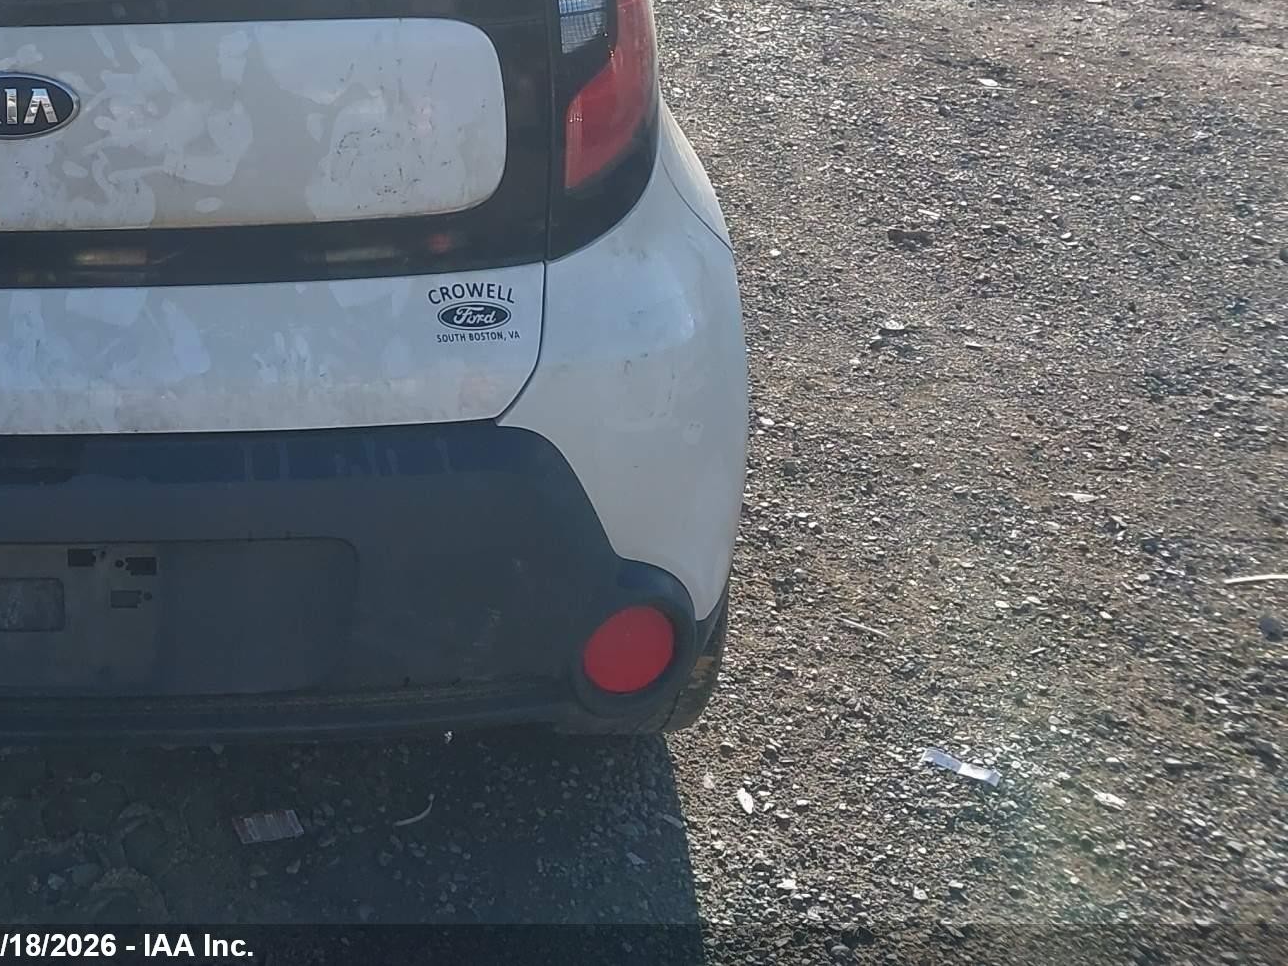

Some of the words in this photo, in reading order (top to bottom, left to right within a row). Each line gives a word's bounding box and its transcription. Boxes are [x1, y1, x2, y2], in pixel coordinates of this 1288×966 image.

[428, 282, 515, 305] CROWELL
[453, 306, 497, 325] Ford
[436, 333, 466, 343] SOUTH
[468, 332, 507, 342] BOSTON,
[508, 330, 521, 340] VA
